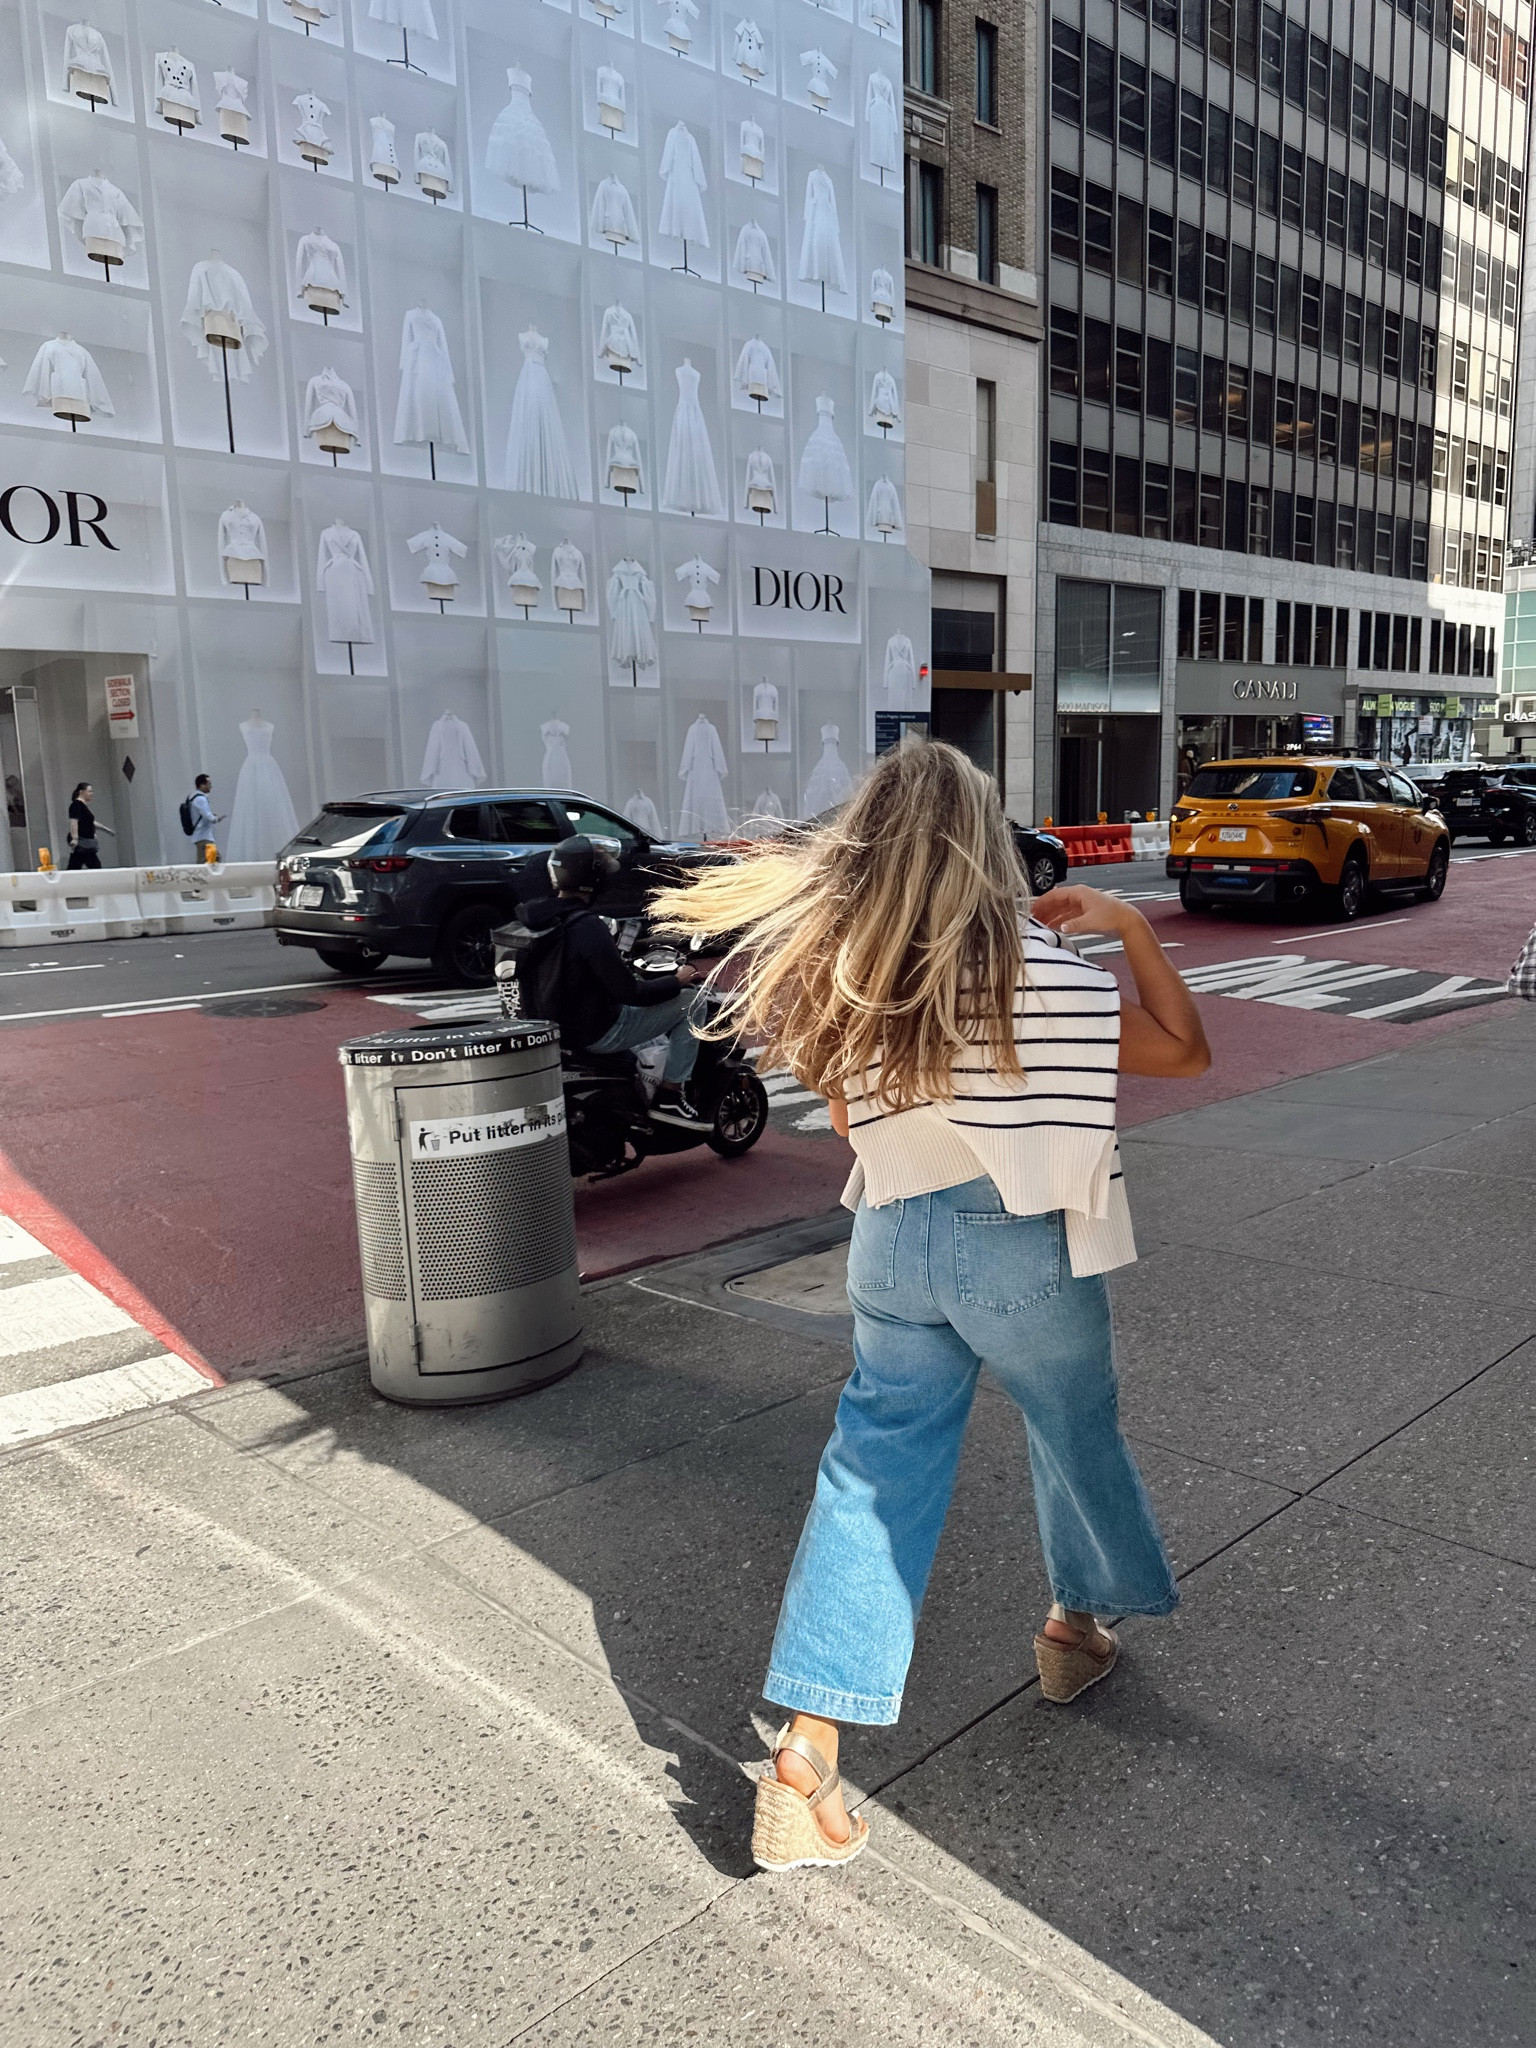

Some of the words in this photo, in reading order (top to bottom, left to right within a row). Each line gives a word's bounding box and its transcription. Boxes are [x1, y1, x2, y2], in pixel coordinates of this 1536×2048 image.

[0, 485, 120, 551] OR
[751, 565, 847, 614] DIOR
[1233, 679, 1299, 700] CANALI
[1395, 701, 1416, 711] VOGUE
[501, 981, 518, 1020] NORTH
[511, 981, 522, 1010] FACE
[411, 1047, 457, 1062] Don't
[463, 1042, 502, 1057] litter
[449, 1128, 481, 1144] Put
[486, 1122, 527, 1140] litter
[528, 1118, 541, 1132] in
[544, 1114, 556, 1128] its
